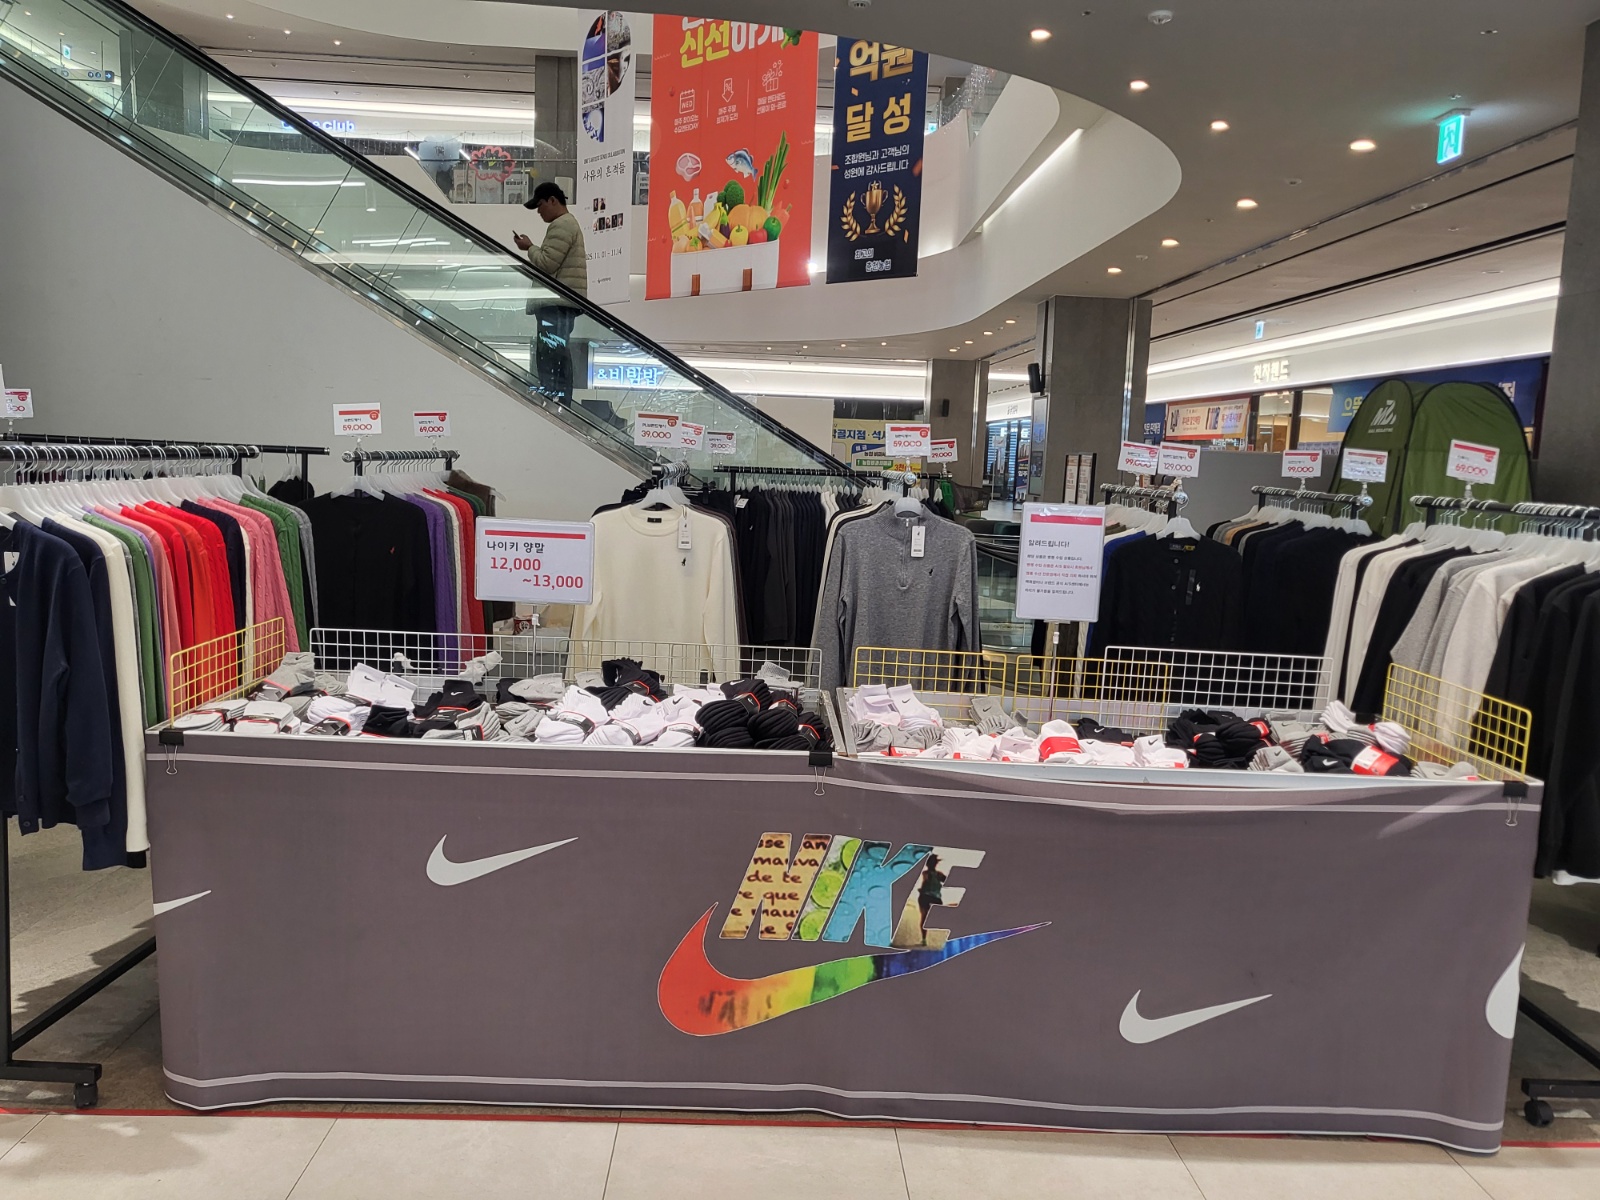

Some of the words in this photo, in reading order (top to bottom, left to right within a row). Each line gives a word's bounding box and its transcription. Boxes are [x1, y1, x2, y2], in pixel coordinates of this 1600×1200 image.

[849, 39, 914, 81] 억원
[322, 119, 355, 132] club
[844, 150, 879, 165] 조합원님과
[880, 144, 910, 160] 고객님의
[583, 167, 602, 183] 사유의
[843, 166, 865, 179] 성원에
[866, 159, 909, 176] 감사드립니다
[1253, 360, 1289, 384] 전자랜드
[342, 424, 372, 432] 59,000
[641, 430, 672, 439] 39,000
[893, 440, 922, 448] 59,000
[1164, 463, 1192, 472] 129,000
[1455, 463, 1488, 477] 69,000
[486, 541, 519, 552] 나이키
[523, 542, 545, 554] 양말
[1028, 539, 1070, 548] 알려드립니다!
[490, 557, 541, 573] 12,000
[522, 574, 583, 591] ~13,000
[747, 870, 773, 883] de
[782, 872, 802, 883] te
[719, 832, 986, 951] NIKE
[763, 891, 800, 906] que
